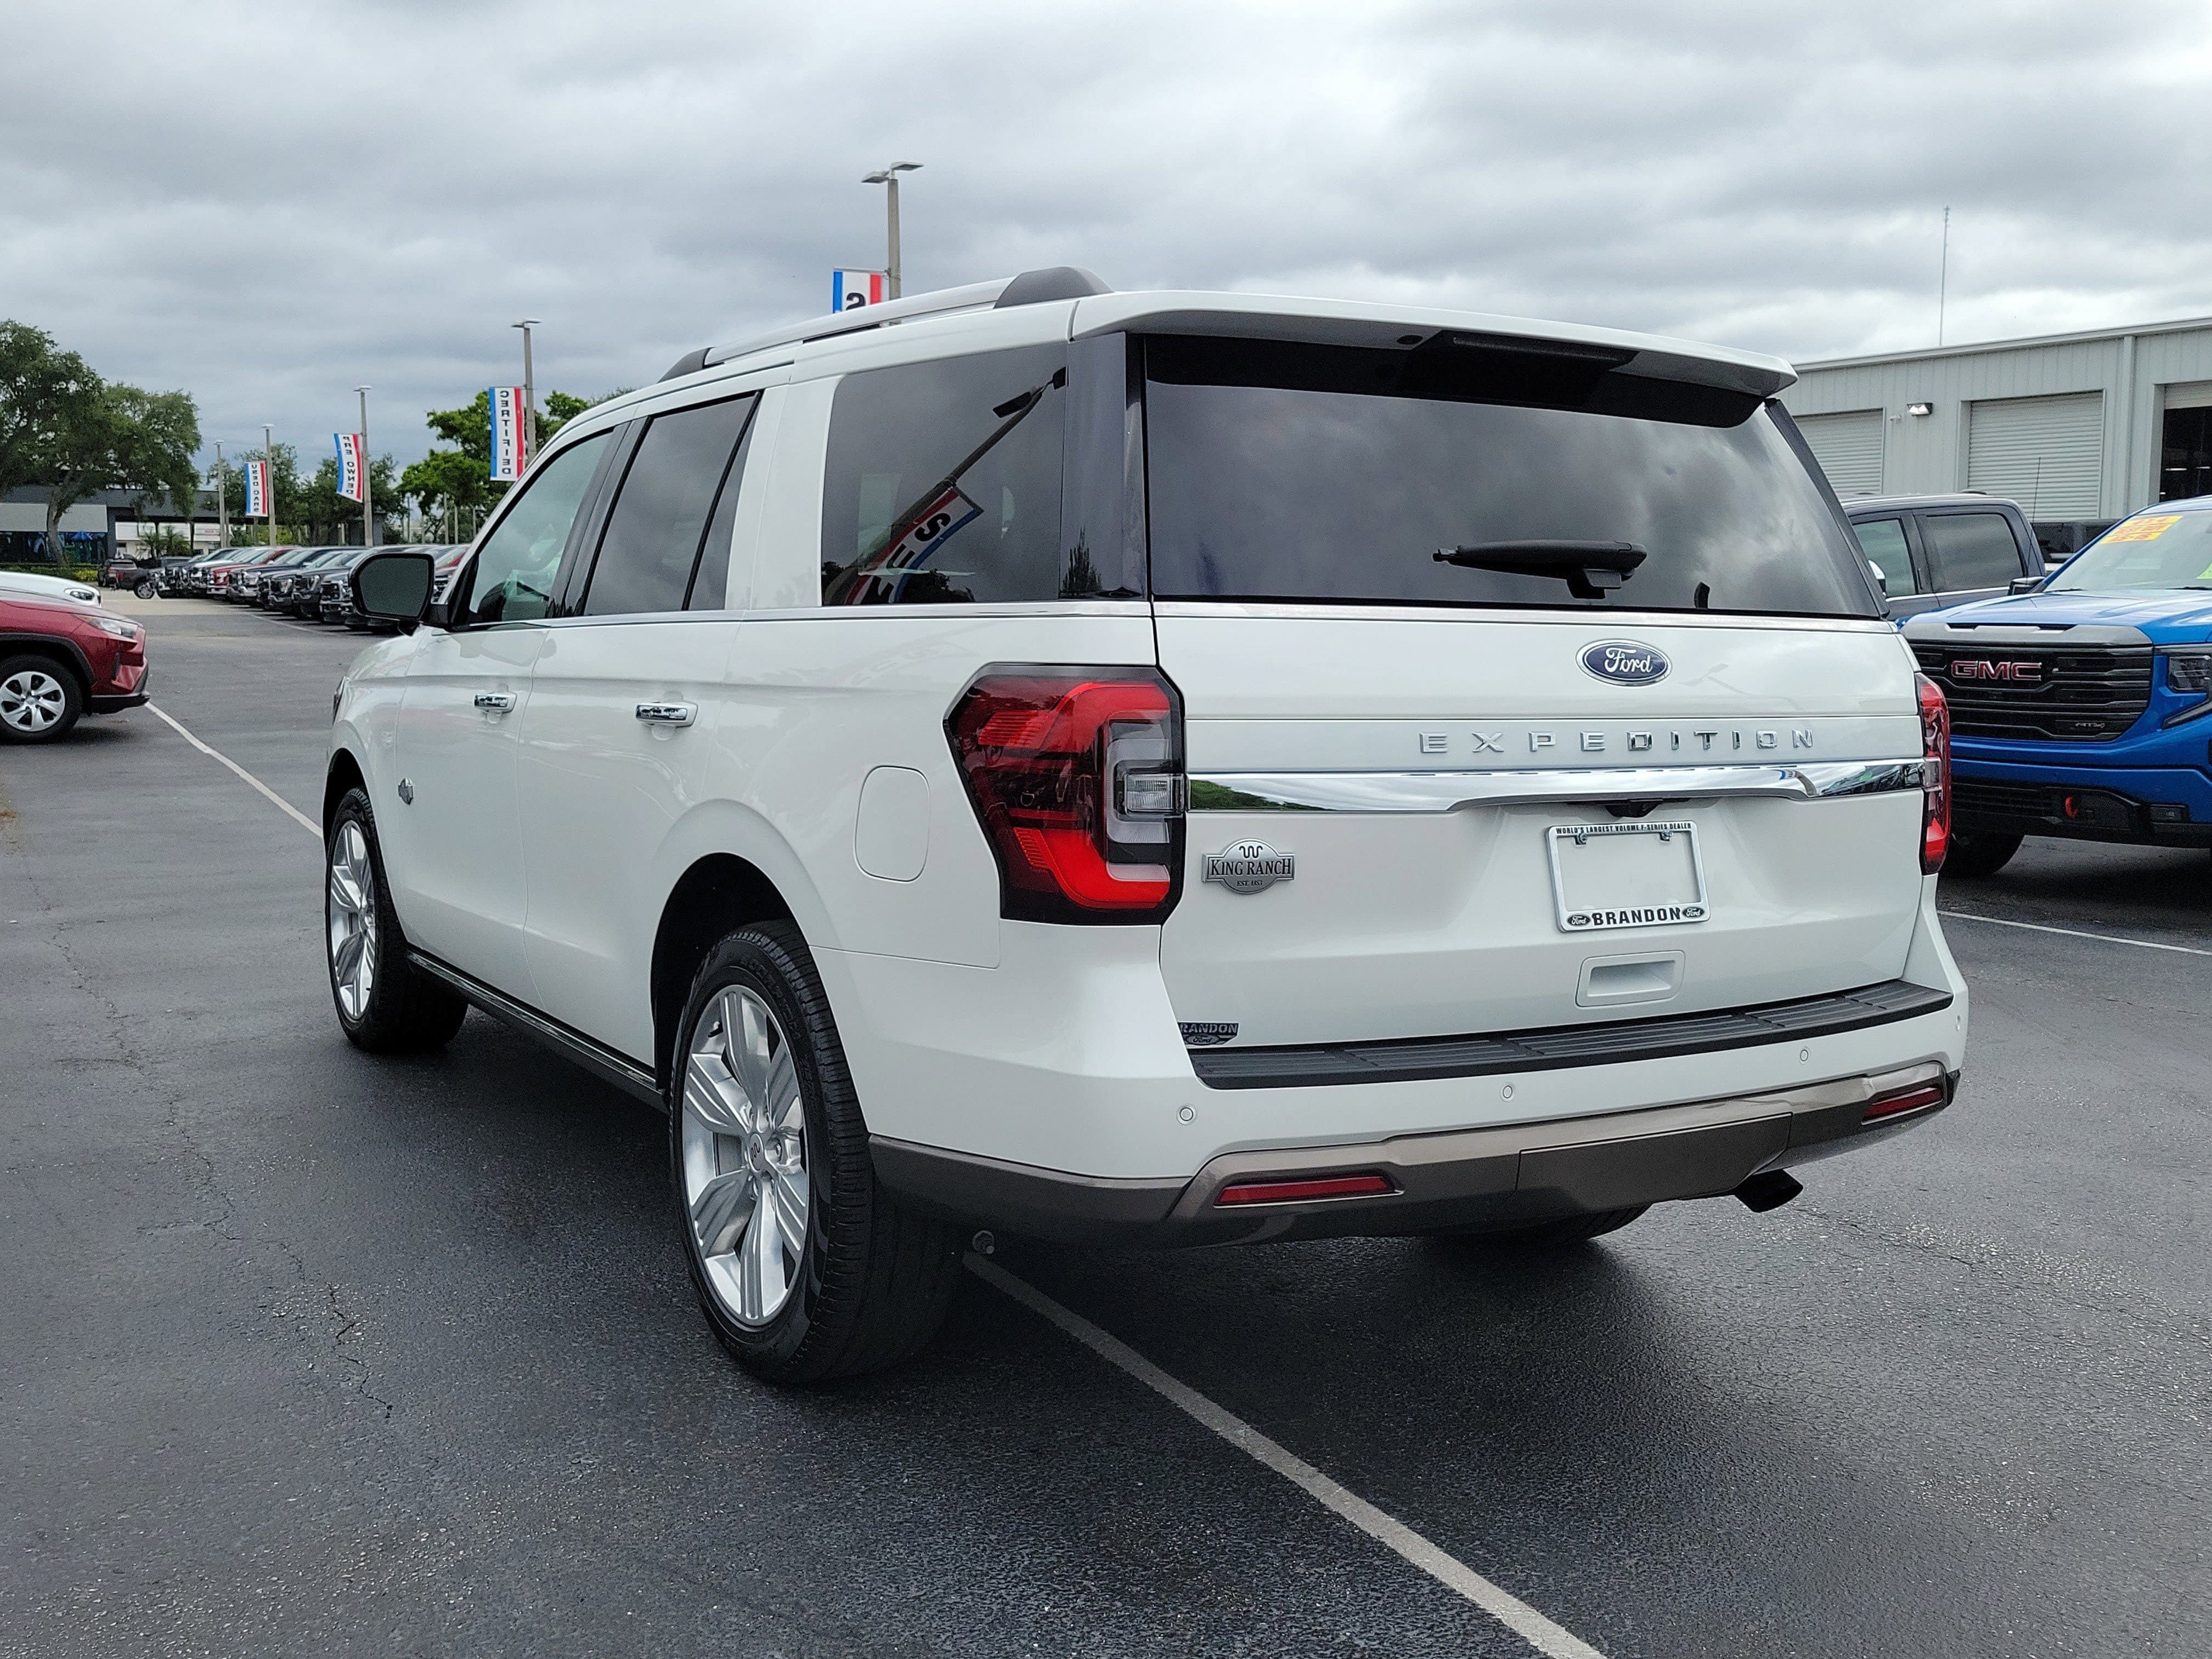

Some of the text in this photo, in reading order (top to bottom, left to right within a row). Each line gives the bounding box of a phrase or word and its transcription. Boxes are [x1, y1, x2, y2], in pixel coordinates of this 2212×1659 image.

[1604, 647, 1652, 673] Ford
[1951, 661, 2042, 681] GMC
[1419, 730, 1813, 753] EXPEDITION
[1210, 858, 1292, 876] KING RANCH
[1571, 907, 1701, 926] Ford BRANDON Ford
[1180, 1023, 1237, 1033] RANDON
